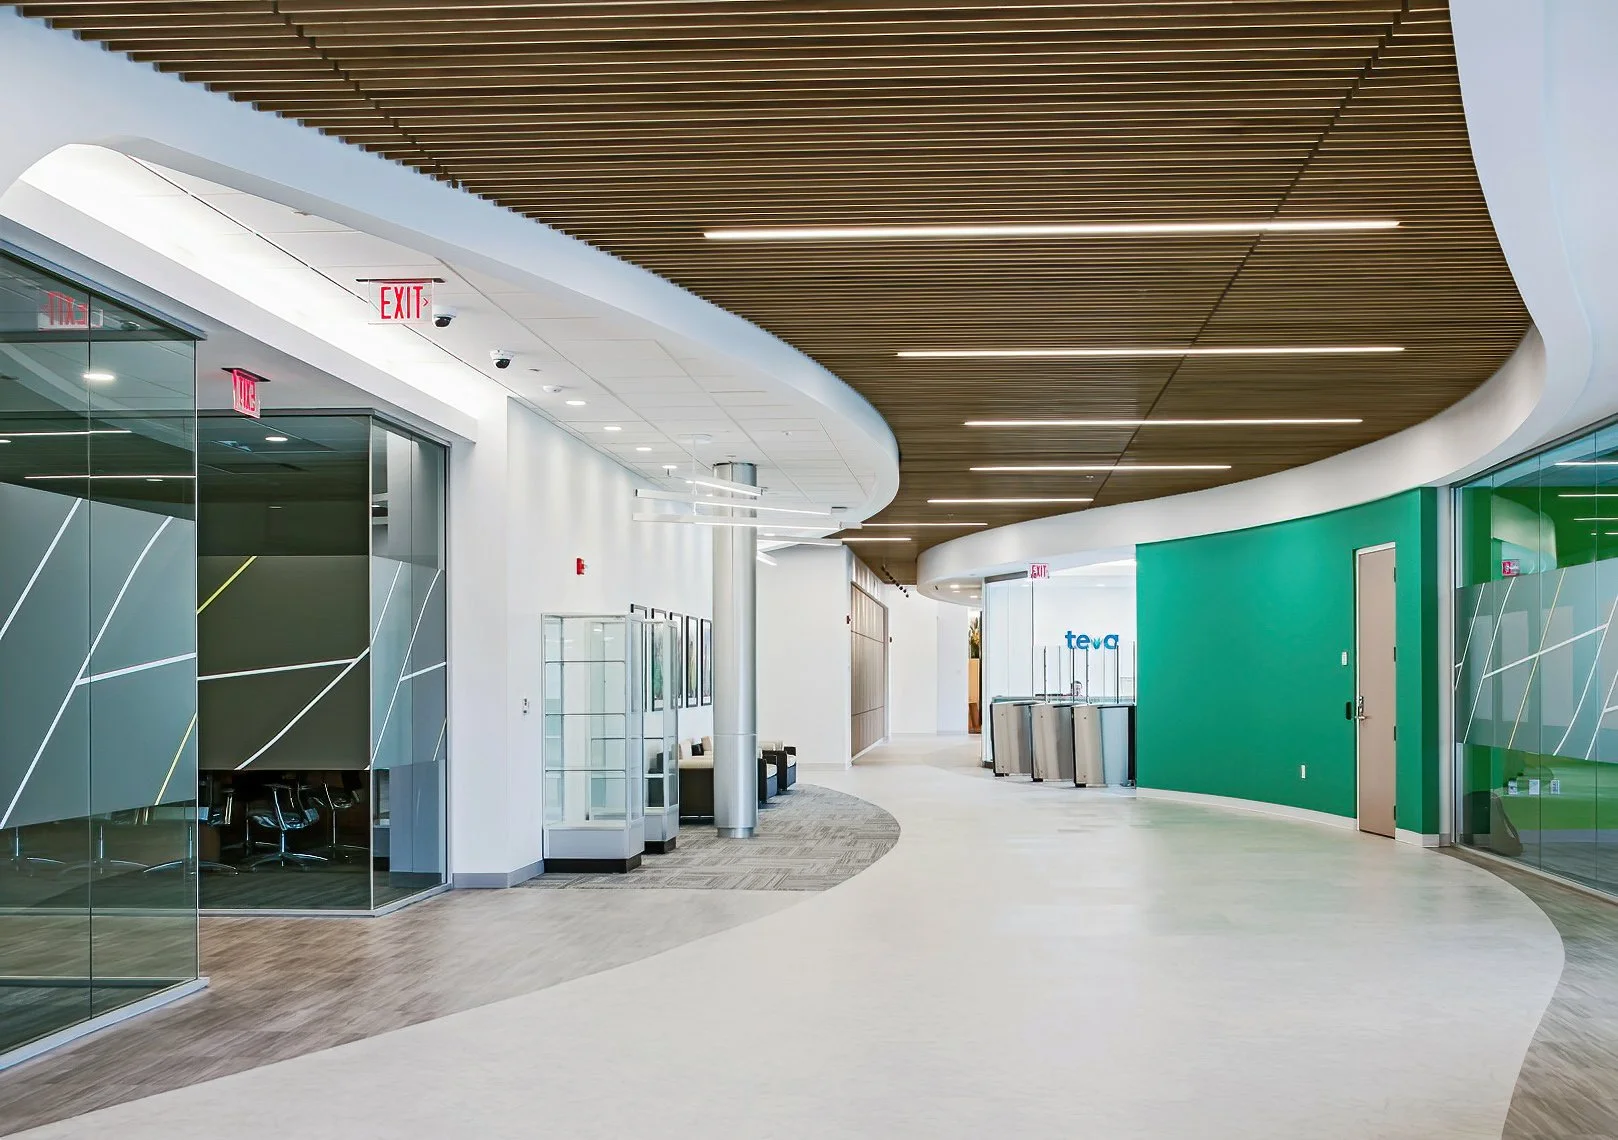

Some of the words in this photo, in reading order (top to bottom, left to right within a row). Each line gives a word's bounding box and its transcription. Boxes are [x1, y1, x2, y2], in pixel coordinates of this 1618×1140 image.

[380, 286, 424, 320] EXIT
[1031, 564, 1047, 579] EXIT
[1064, 630, 1119, 650] teva
